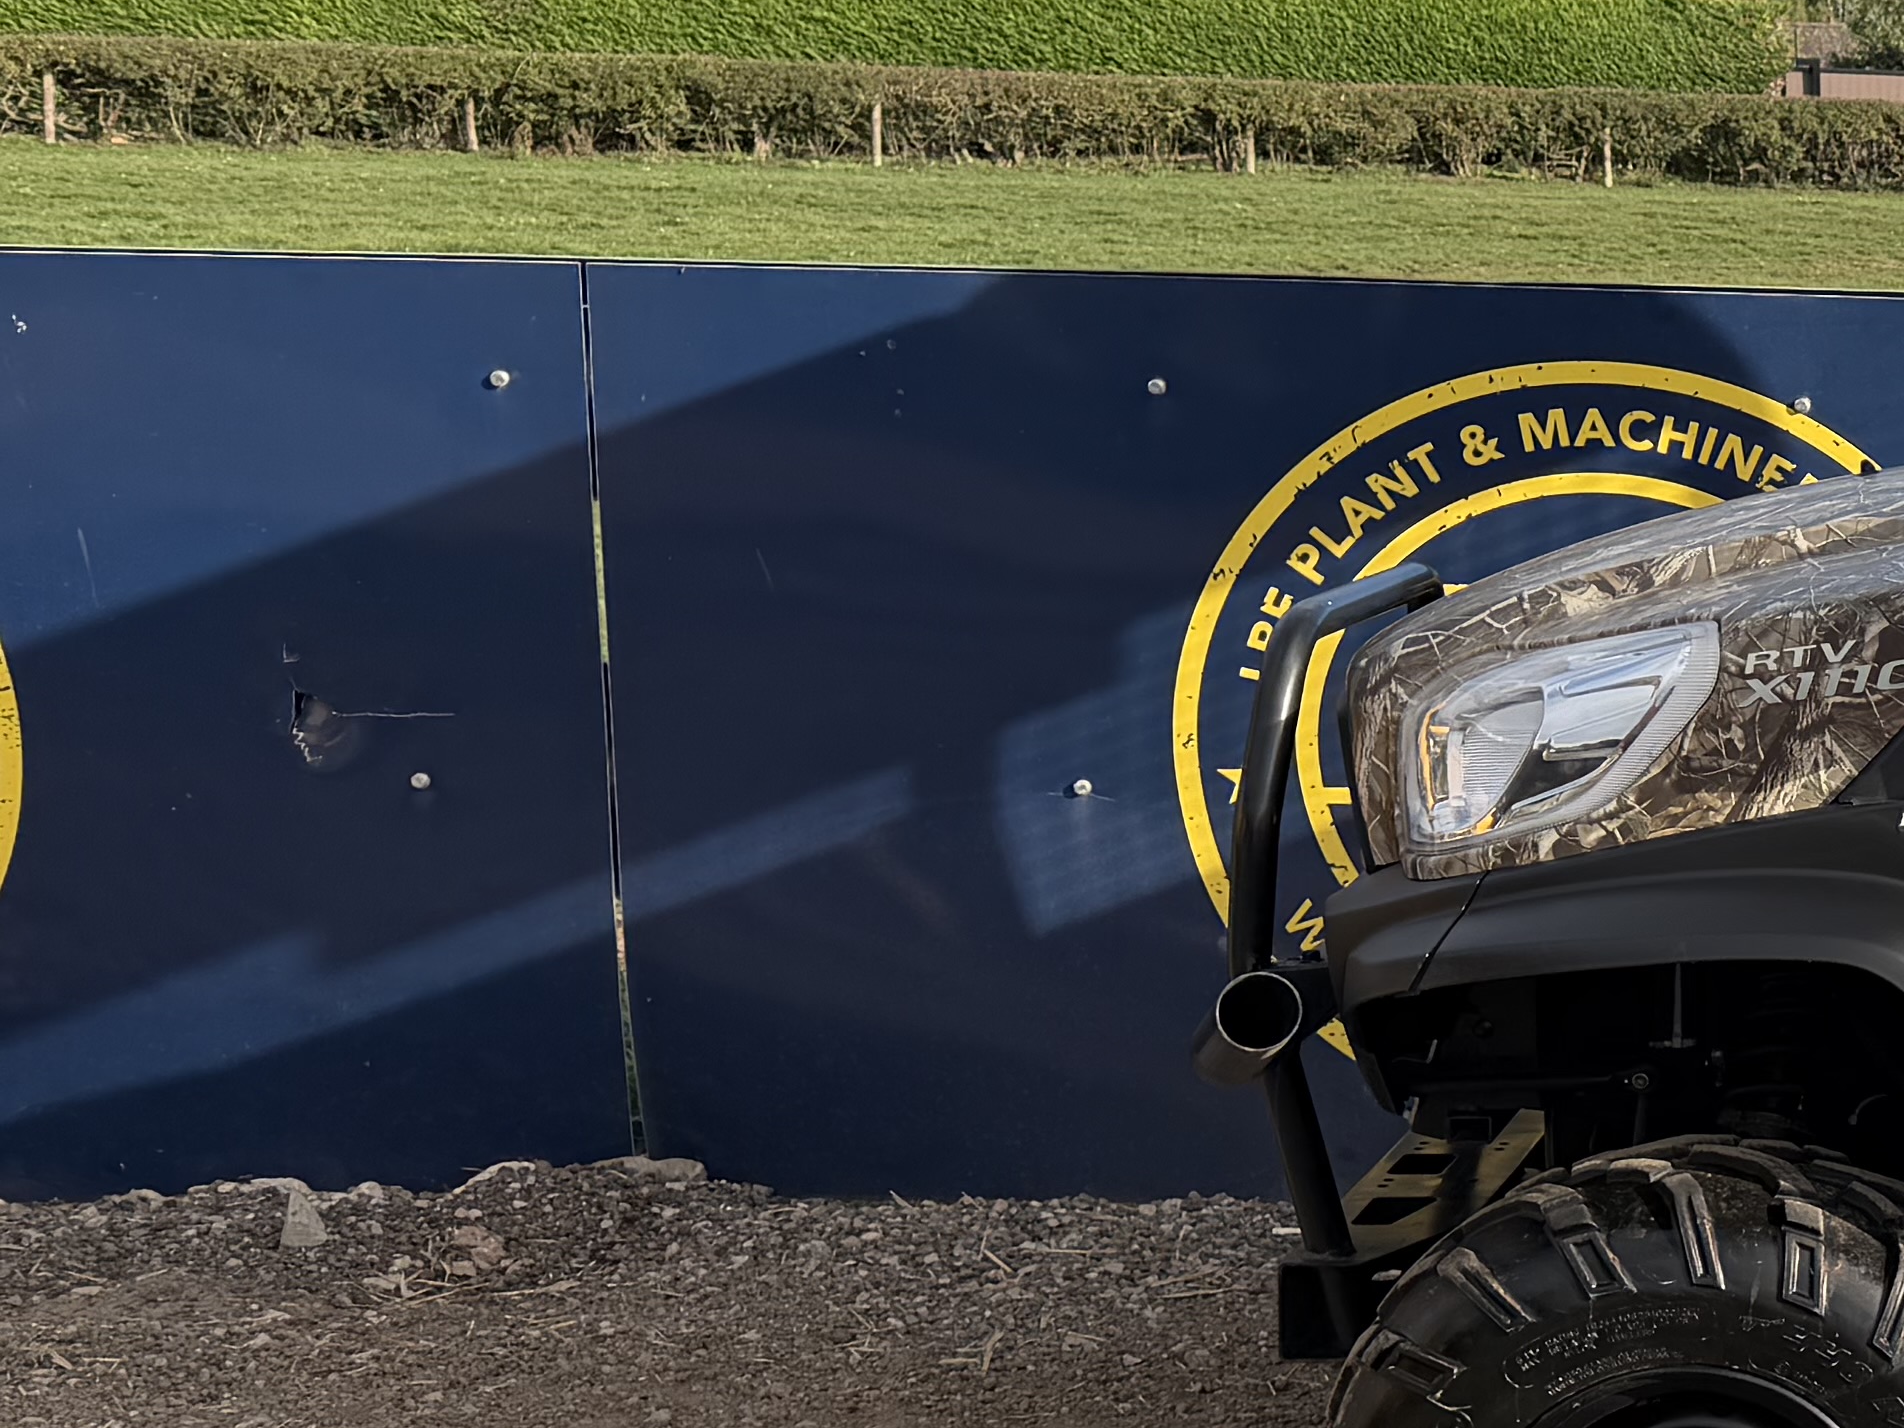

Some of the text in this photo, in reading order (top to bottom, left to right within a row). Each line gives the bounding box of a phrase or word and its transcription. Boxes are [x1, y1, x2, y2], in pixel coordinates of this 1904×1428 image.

[1286, 441, 1441, 586] PLANT
[1460, 424, 1505, 466] &
[1518, 407, 1819, 493] MACHINE
[1744, 639, 1857, 675] RTV
